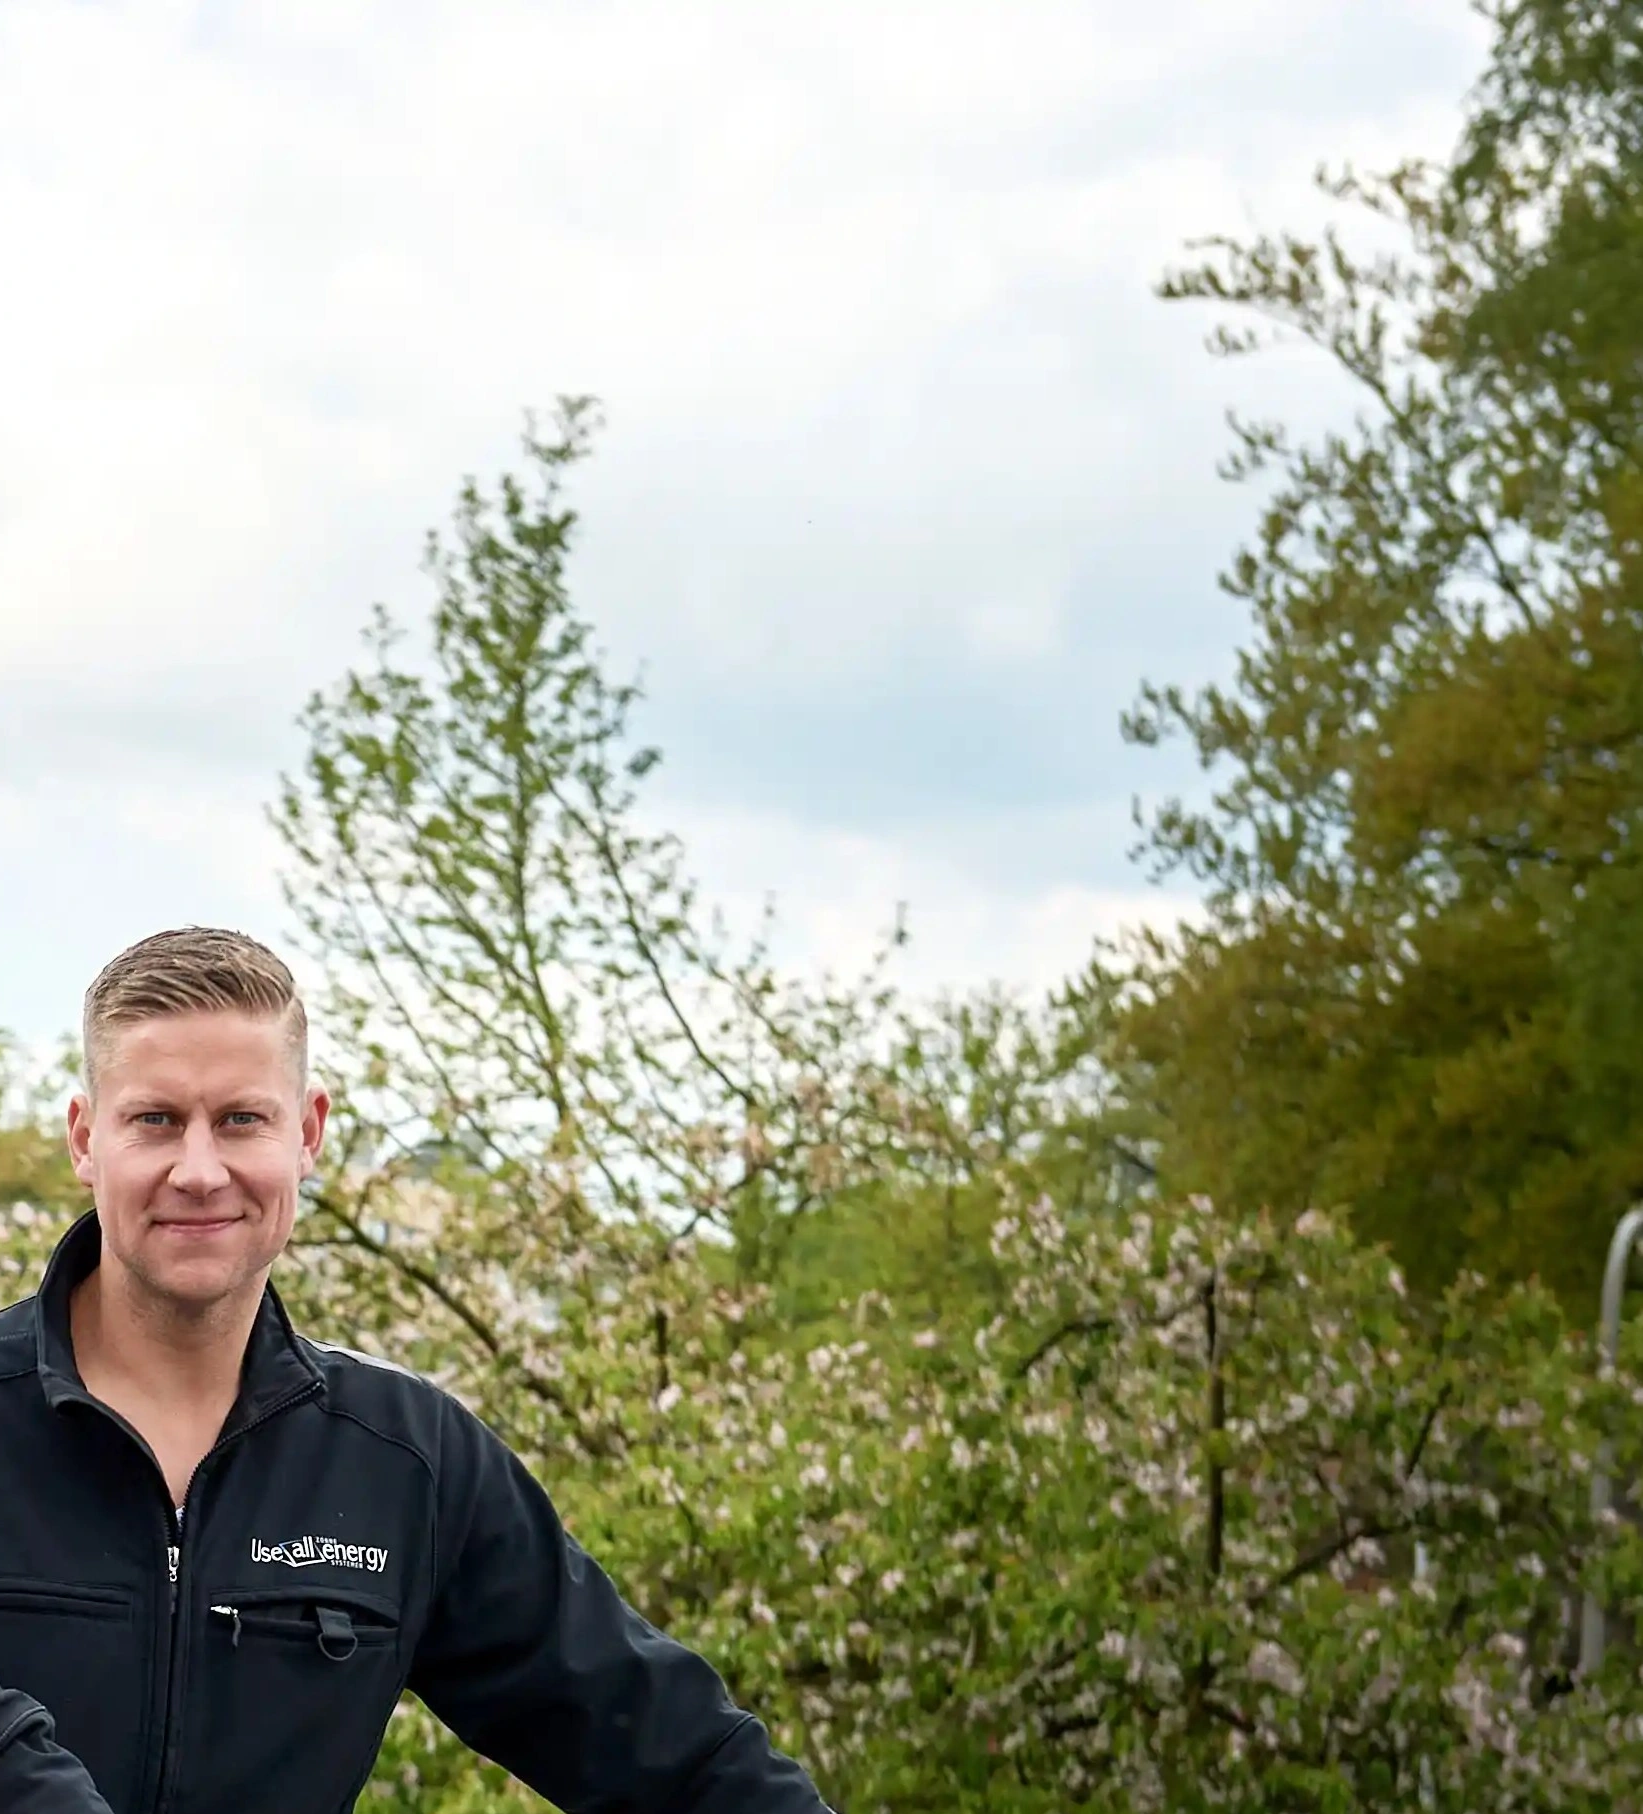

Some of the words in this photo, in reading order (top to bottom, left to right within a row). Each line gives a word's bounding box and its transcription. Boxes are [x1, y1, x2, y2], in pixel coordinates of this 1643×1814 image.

[251, 1538, 283, 1563] Use
[291, 1535, 315, 1558] all
[322, 1543, 389, 1573] energy
